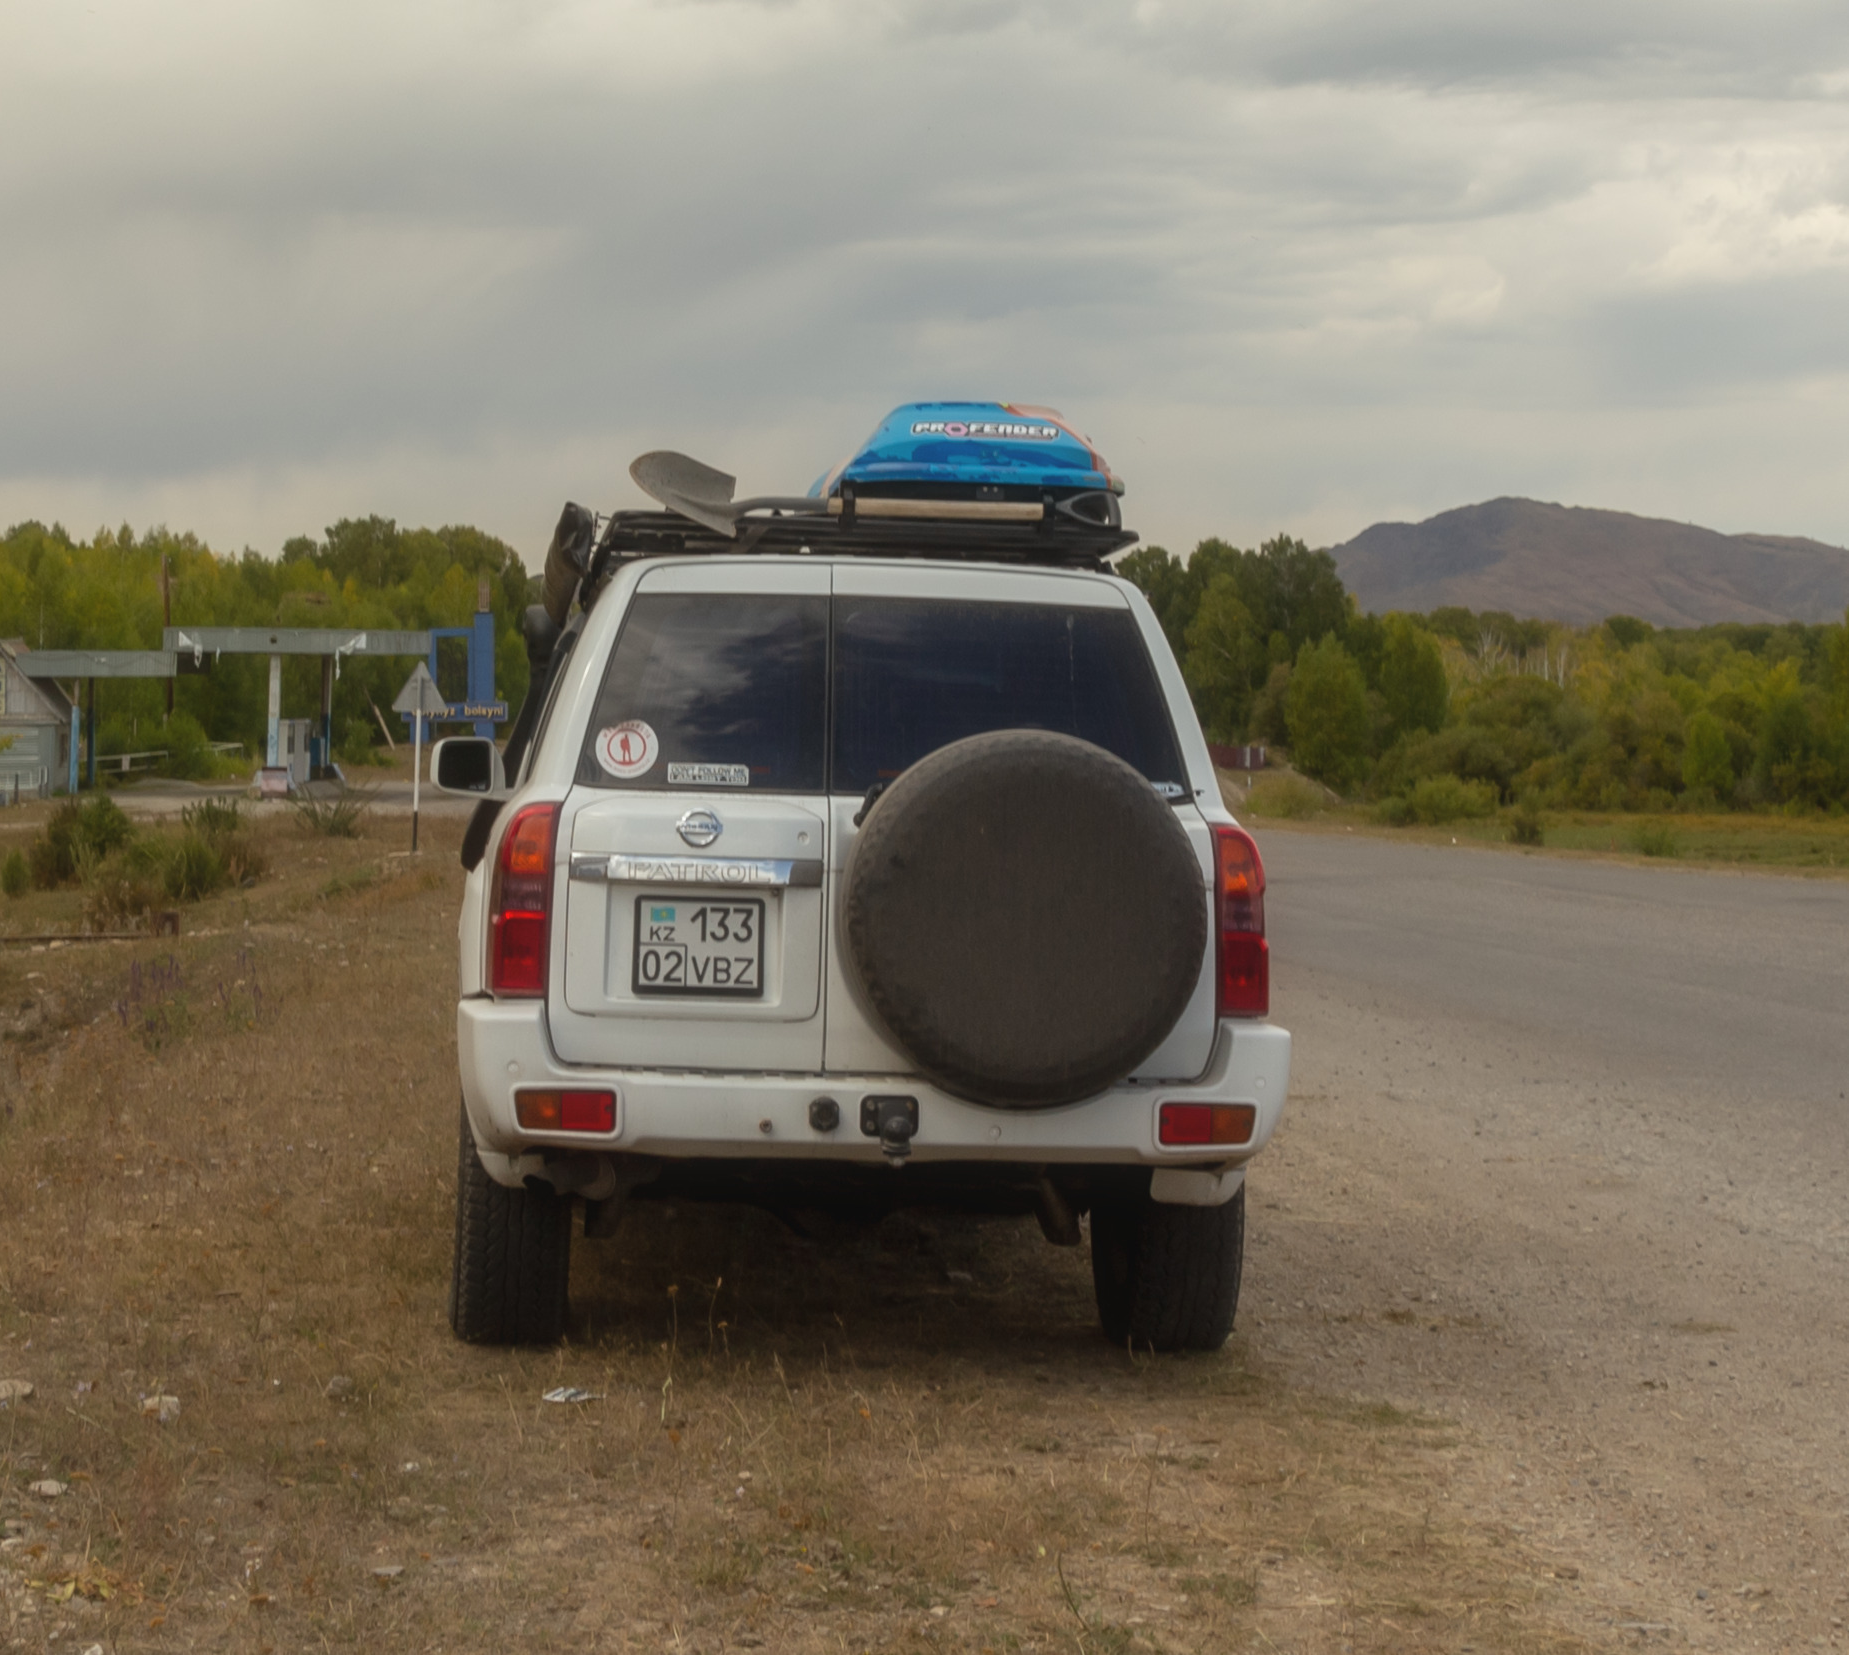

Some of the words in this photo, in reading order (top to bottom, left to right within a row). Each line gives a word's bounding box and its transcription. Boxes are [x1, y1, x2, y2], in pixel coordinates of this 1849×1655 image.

[913, 422, 1059, 438] PROFENDER
[628, 860, 771, 884] PATROL
[650, 926, 676, 942] KZ
[690, 906, 754, 943] 133
[642, 949, 683, 983] 02
[691, 955, 754, 985] VBZ
